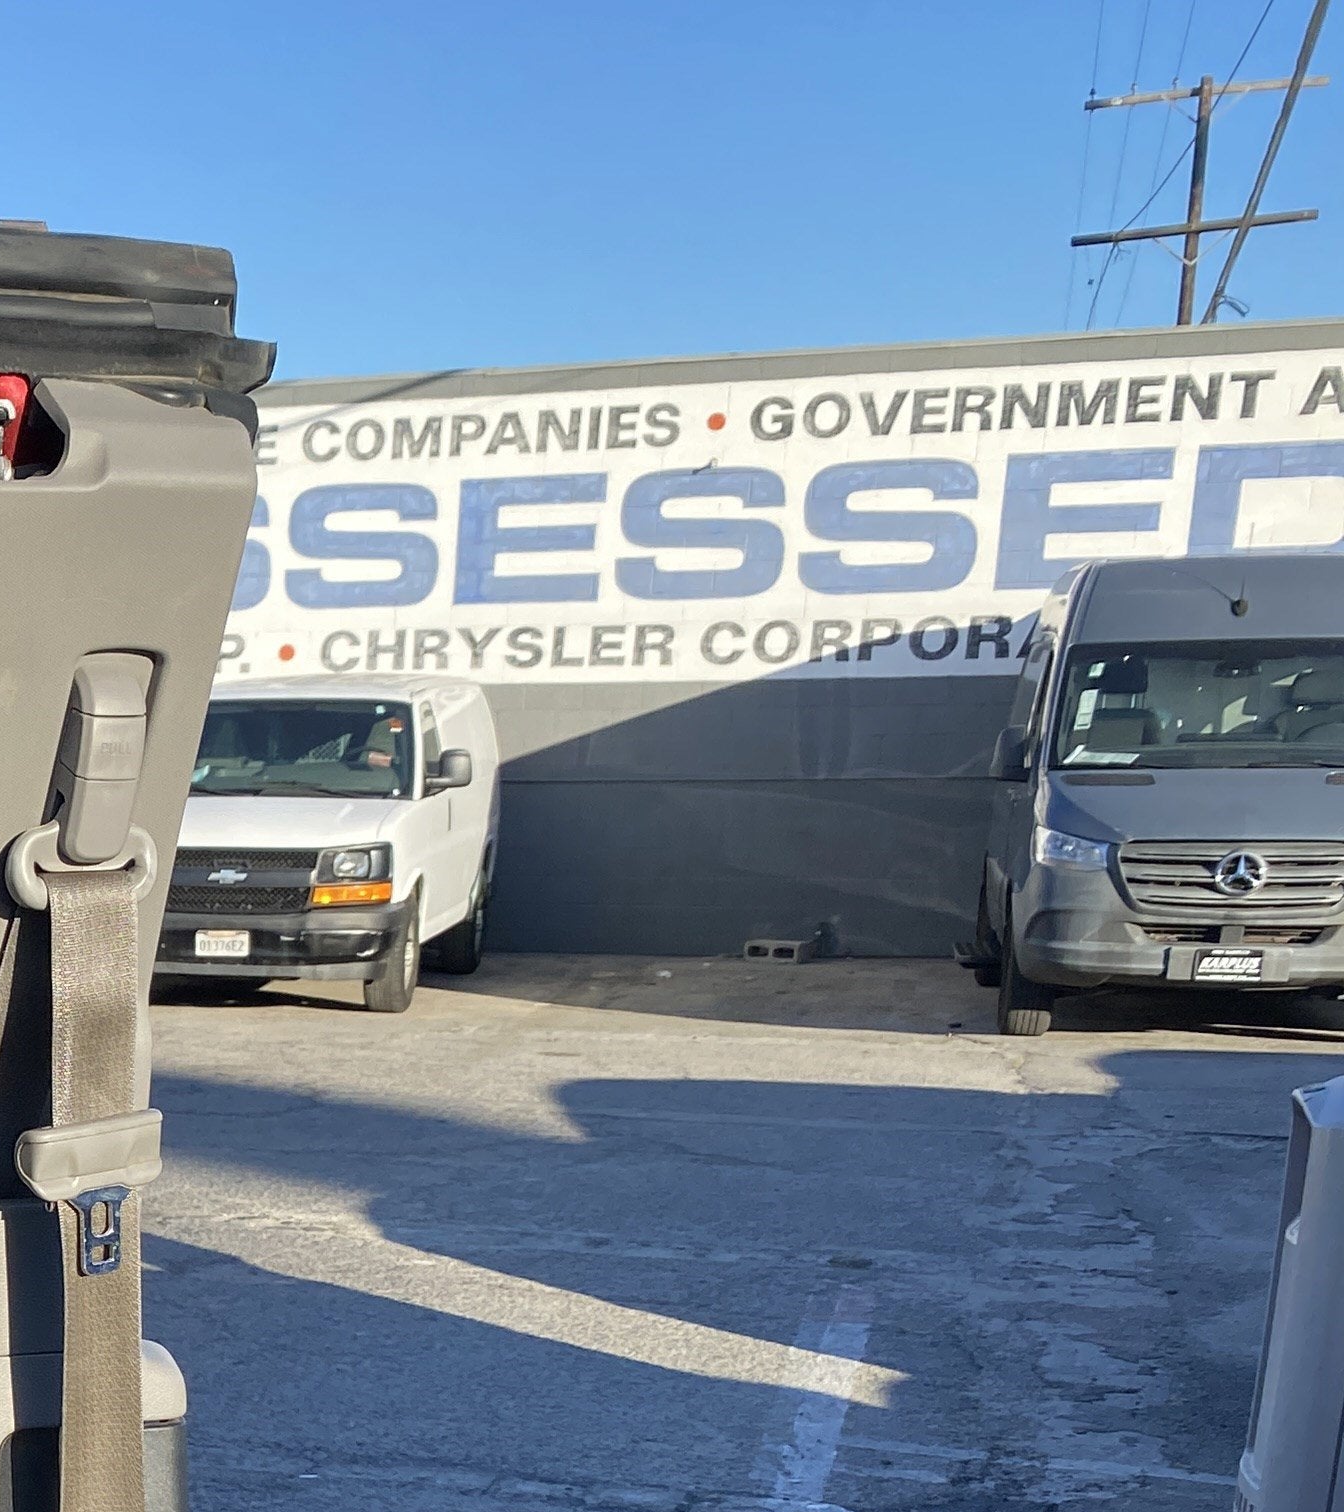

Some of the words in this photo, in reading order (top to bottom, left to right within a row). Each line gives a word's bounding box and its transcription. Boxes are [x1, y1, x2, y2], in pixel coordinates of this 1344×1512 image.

[301, 403, 681, 462] COMPANIES
[749, 369, 1277, 441] GOVERNMENT
[320, 623, 676, 673] CHRYSLER
